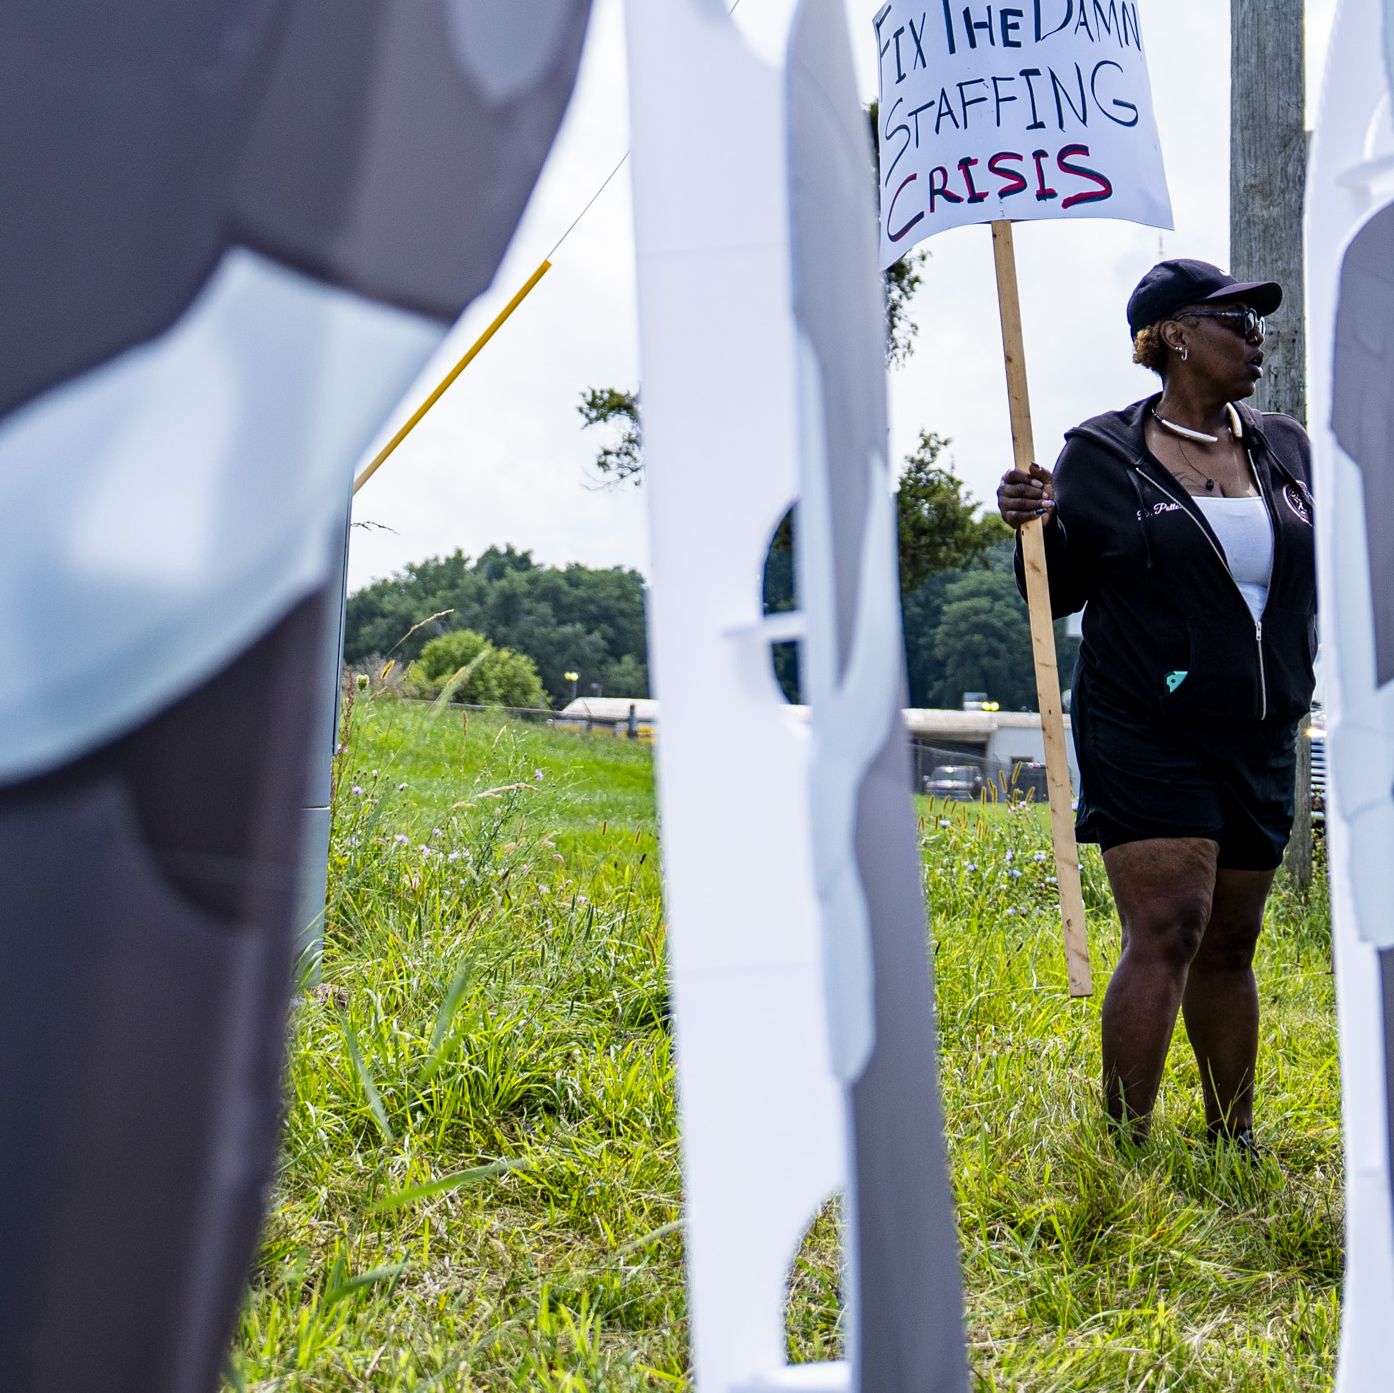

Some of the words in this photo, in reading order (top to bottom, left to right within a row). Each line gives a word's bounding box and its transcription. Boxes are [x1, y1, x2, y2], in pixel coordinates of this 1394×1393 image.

[874, 4, 928, 103] FIX
[884, 59, 1140, 188] STAFFING
[887, 143, 1113, 243] CRISIS
